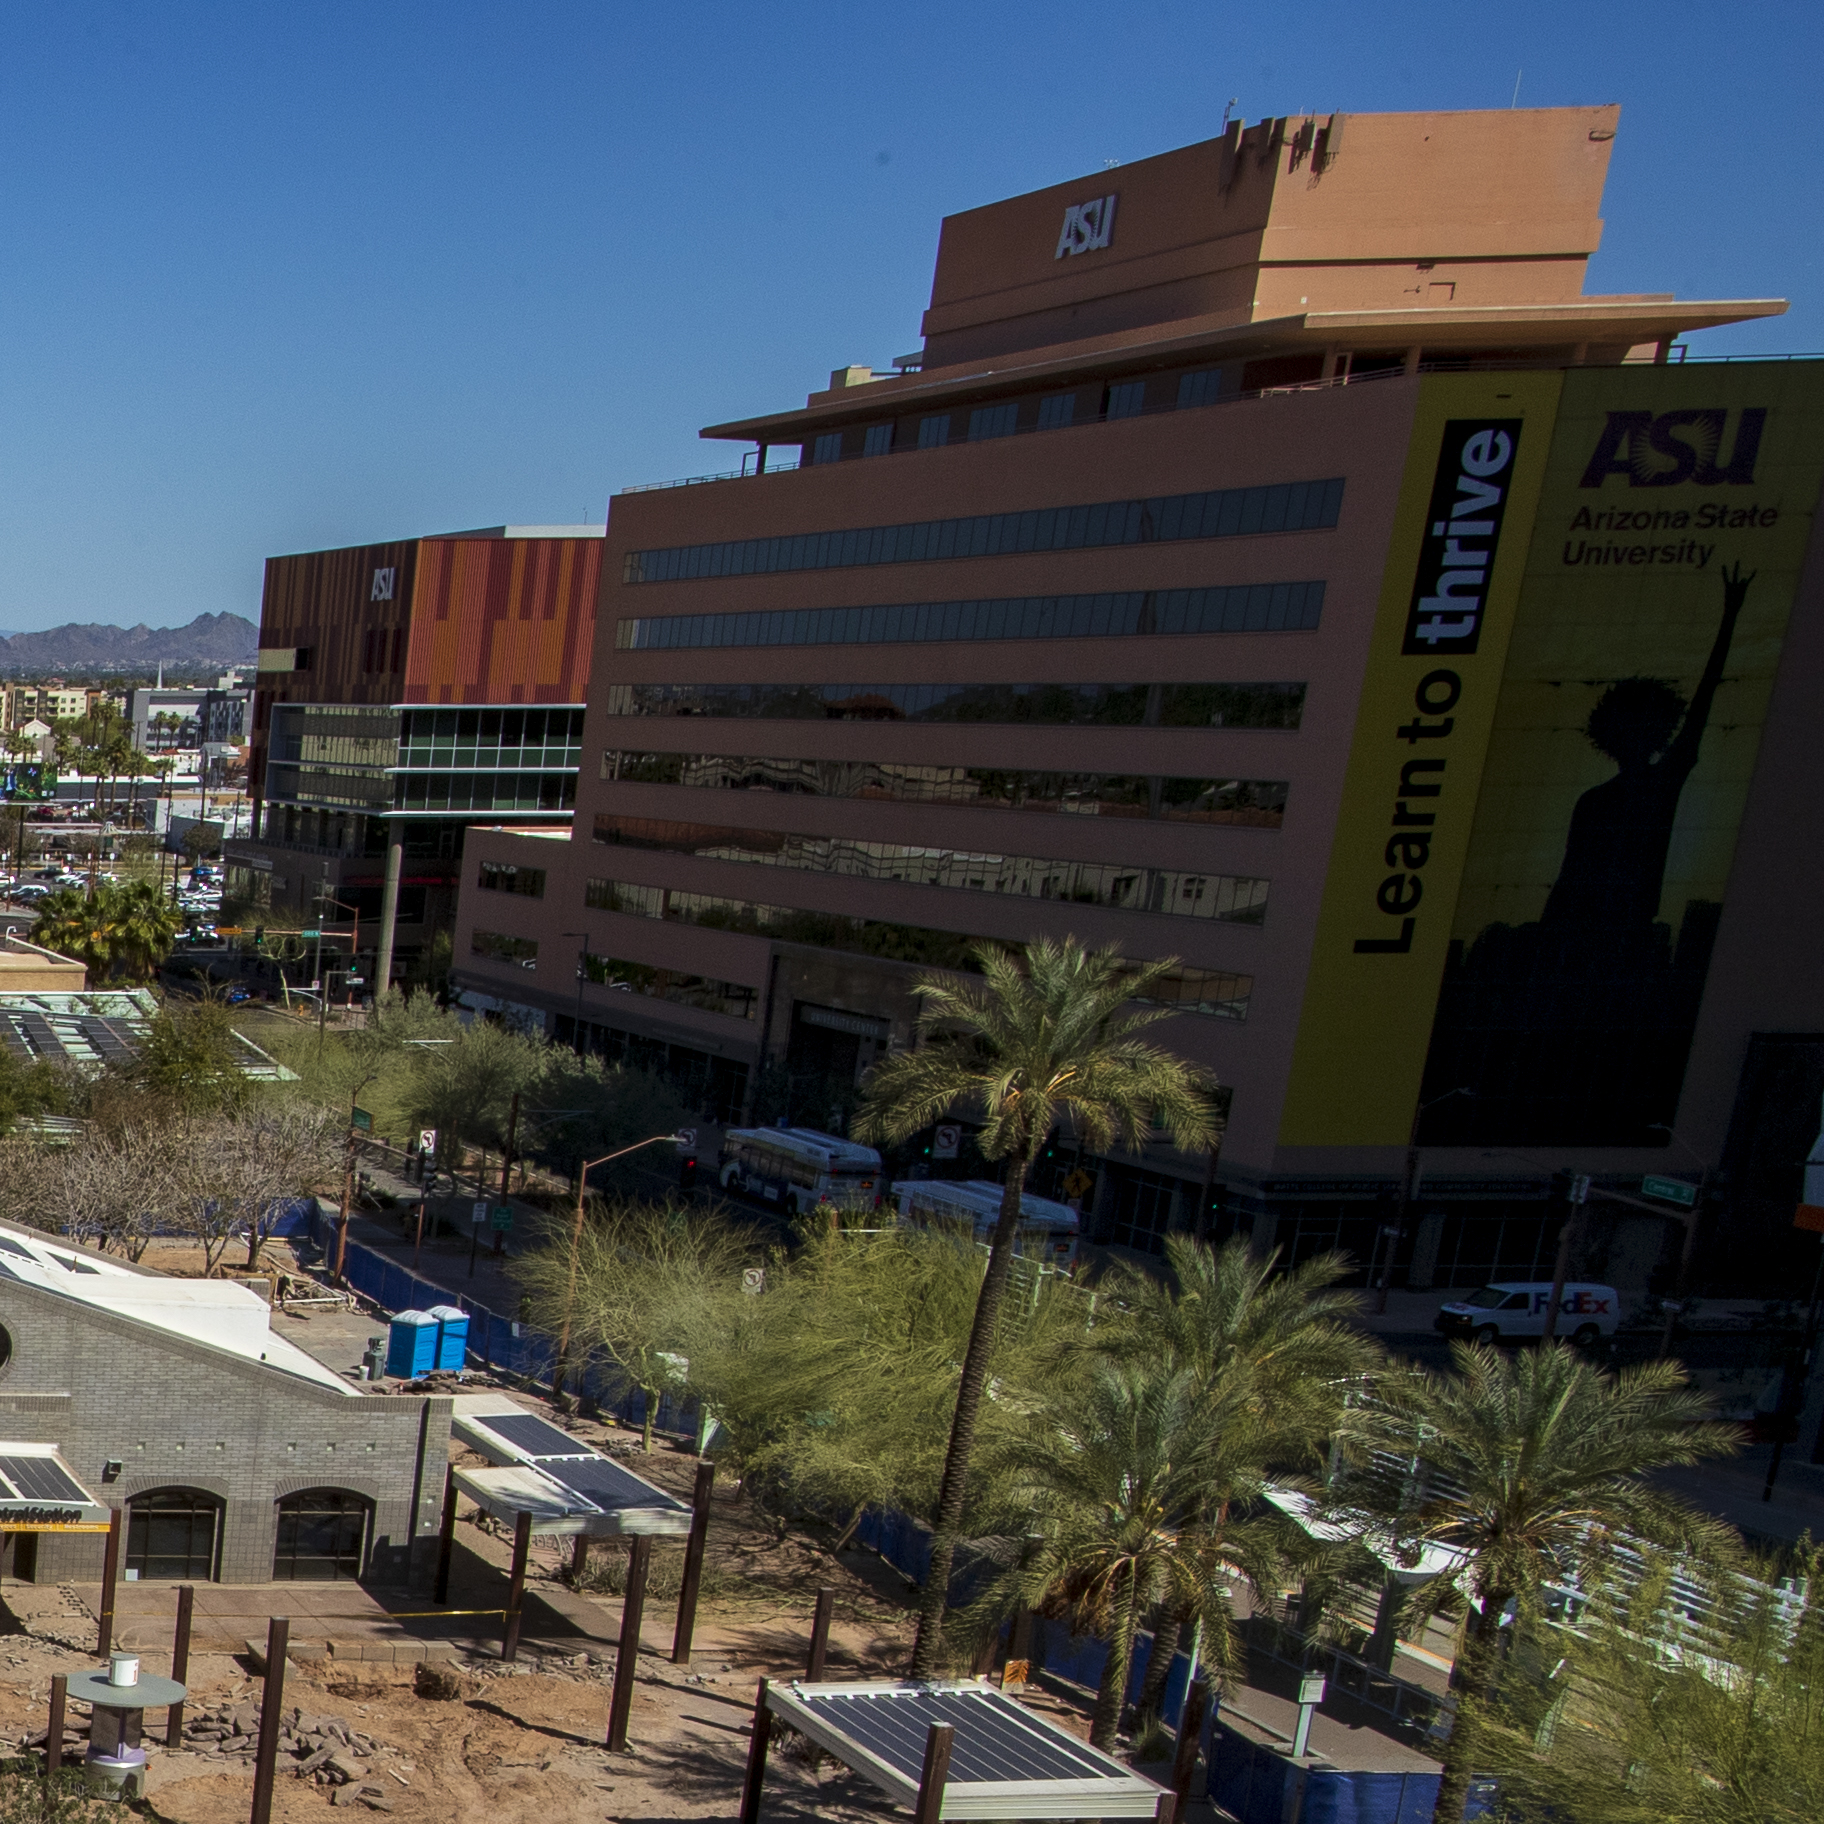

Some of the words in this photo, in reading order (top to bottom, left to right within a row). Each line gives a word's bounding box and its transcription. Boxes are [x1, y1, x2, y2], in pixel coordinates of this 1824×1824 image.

[1055, 195, 1118, 260] ASU
[1581, 408, 1768, 489] ASU
[1416, 428, 1514, 646] thrive
[1570, 503, 1691, 533] Arizona
[1696, 501, 1778, 531] State
[370, 566, 394, 602] ASU
[1561, 538, 1715, 573] University
[1397, 667, 1463, 746] to
[1353, 756, 1446, 956] Learn
[810, 1012, 850, 1029] UNIVERSITY
[851, 1020, 879, 1036] CENTER
